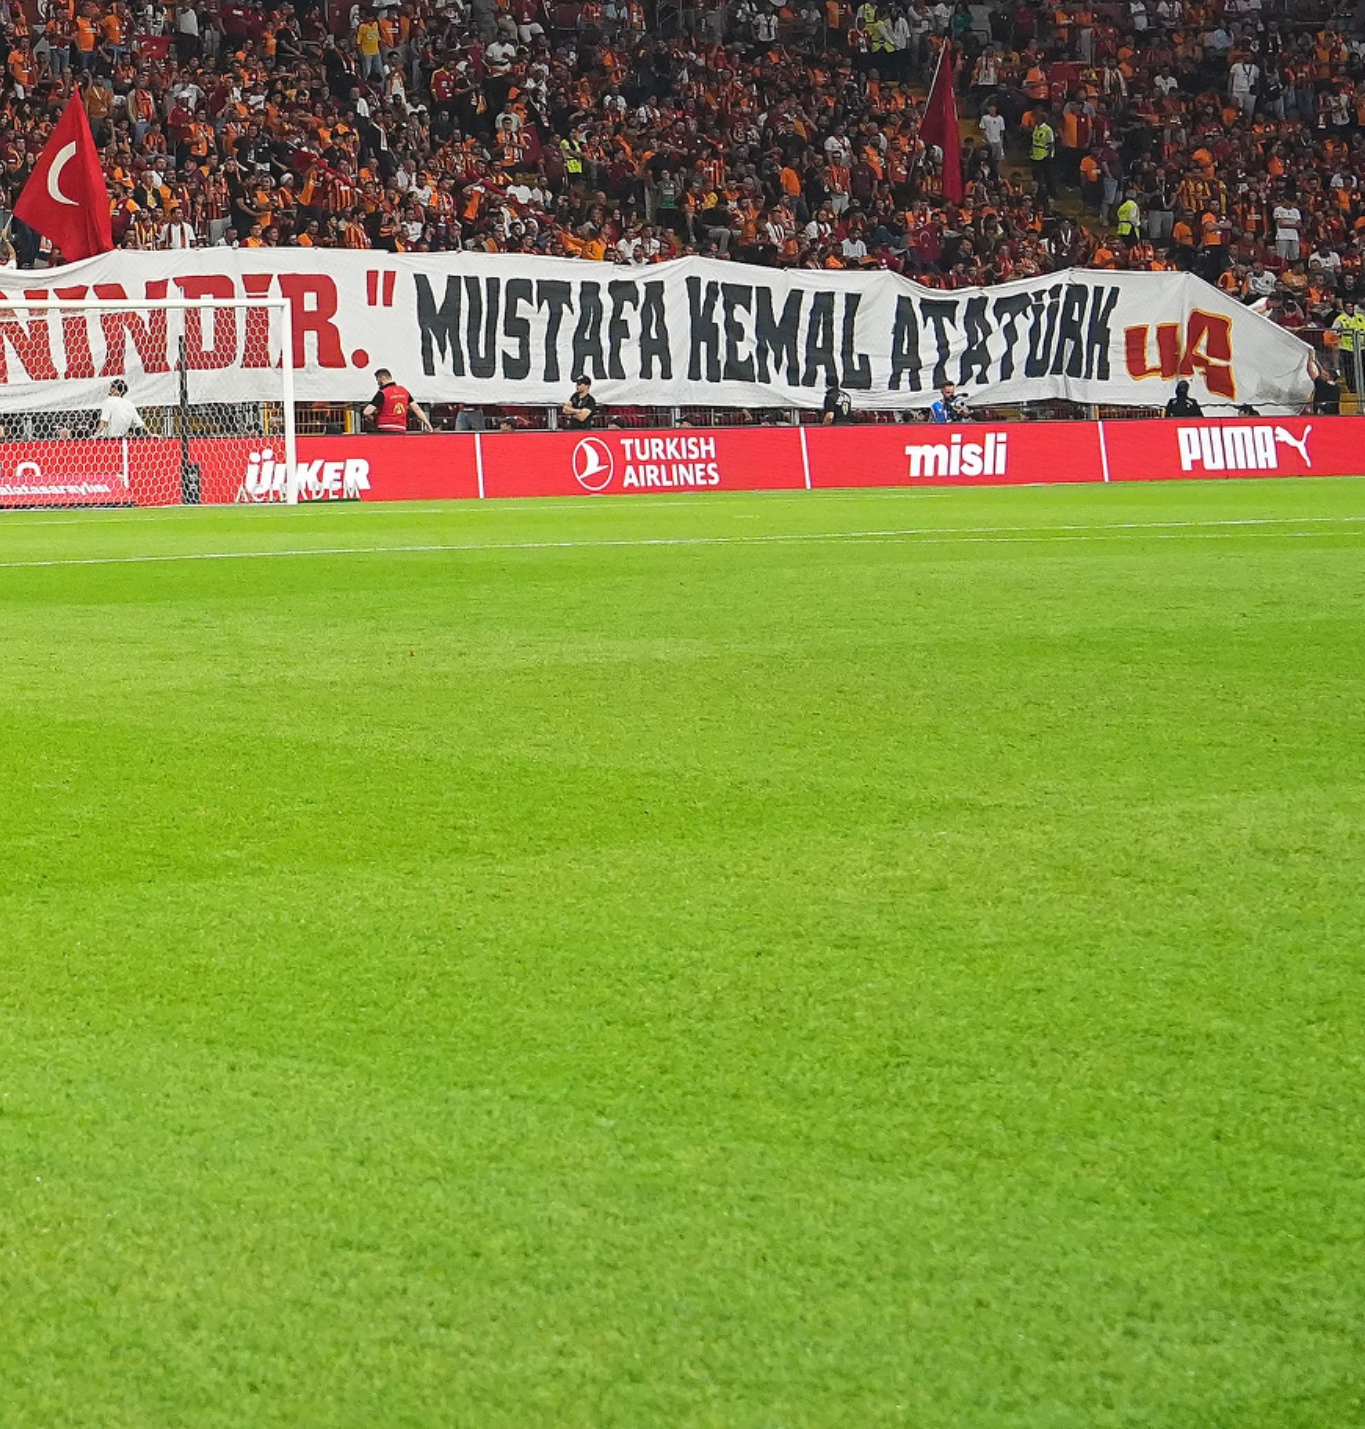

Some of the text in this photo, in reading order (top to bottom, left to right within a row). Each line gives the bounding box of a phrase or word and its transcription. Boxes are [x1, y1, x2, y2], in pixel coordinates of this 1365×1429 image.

[413, 273, 669, 384] MUSTAFA
[685, 275, 871, 389] KEMAL
[888, 282, 1119, 391] ATATÜRK
[620, 437, 716, 460] TURKISH
[906, 432, 1007, 477] misli
[1177, 426, 1278, 470] PUMA
[623, 463, 720, 487] AIRLINES
